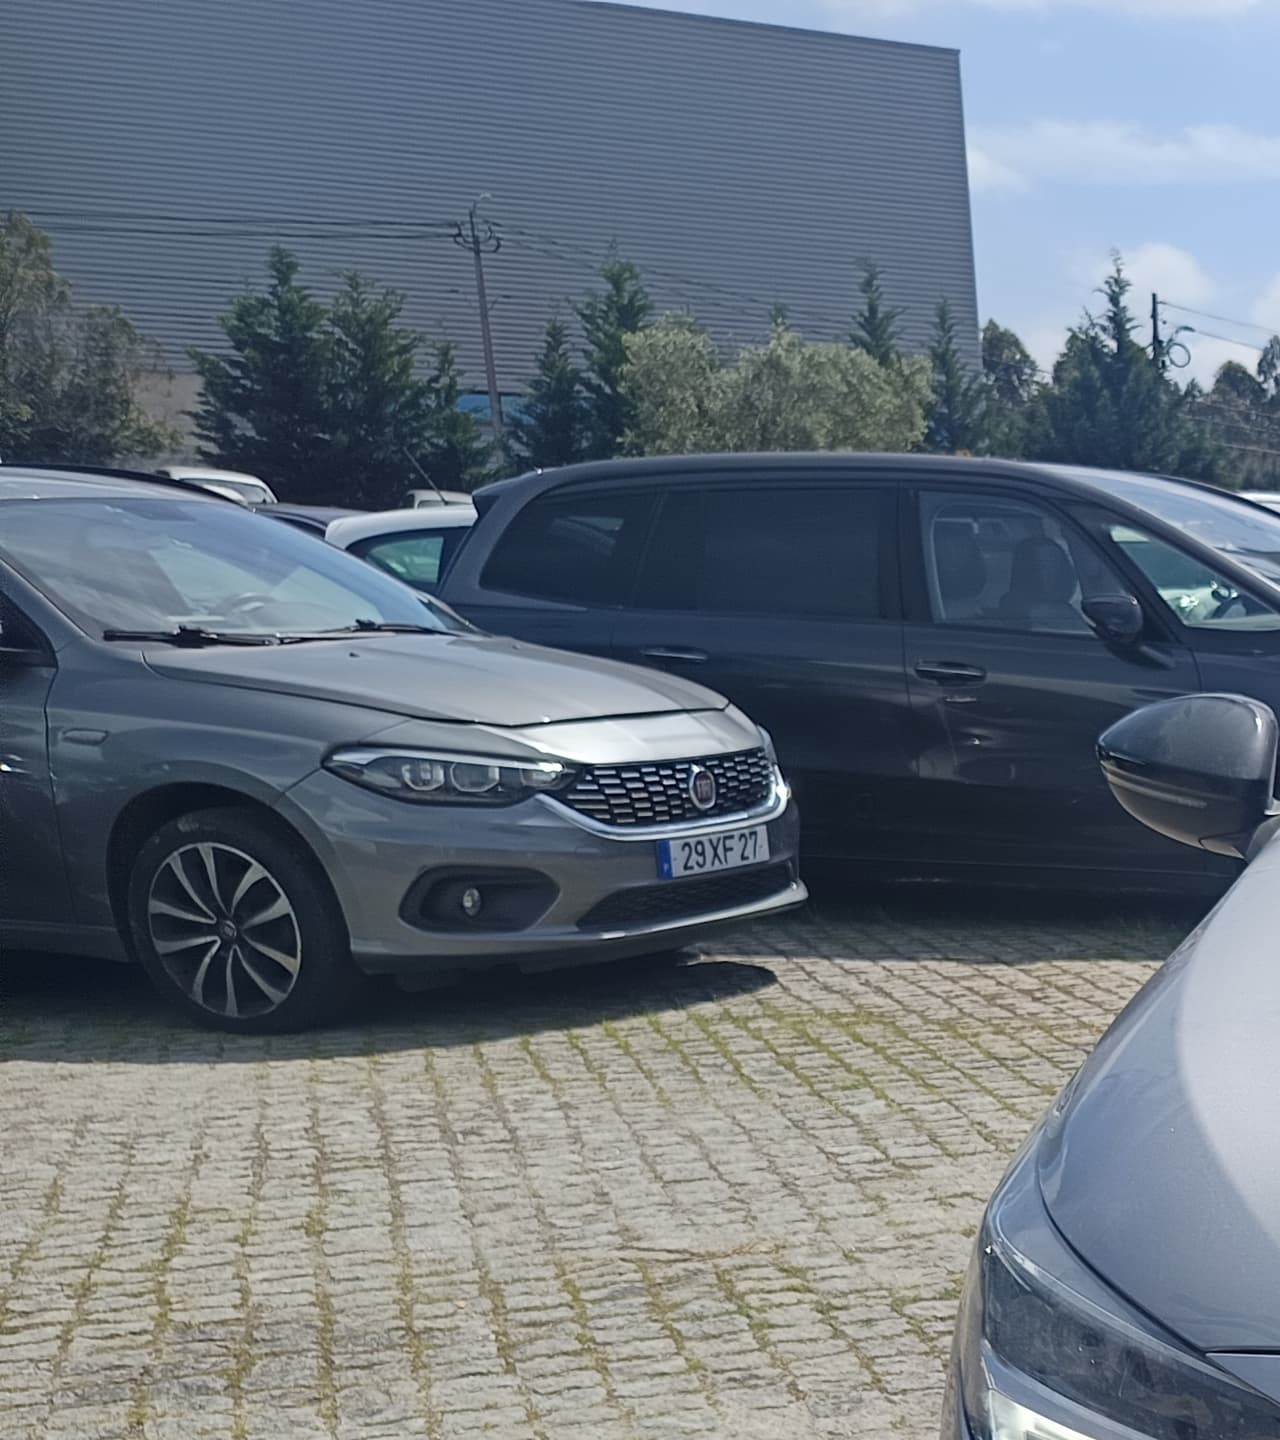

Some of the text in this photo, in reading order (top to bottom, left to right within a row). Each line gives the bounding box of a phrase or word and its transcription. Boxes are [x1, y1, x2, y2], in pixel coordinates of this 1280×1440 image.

[681, 830, 758, 871] 29 XF 27
